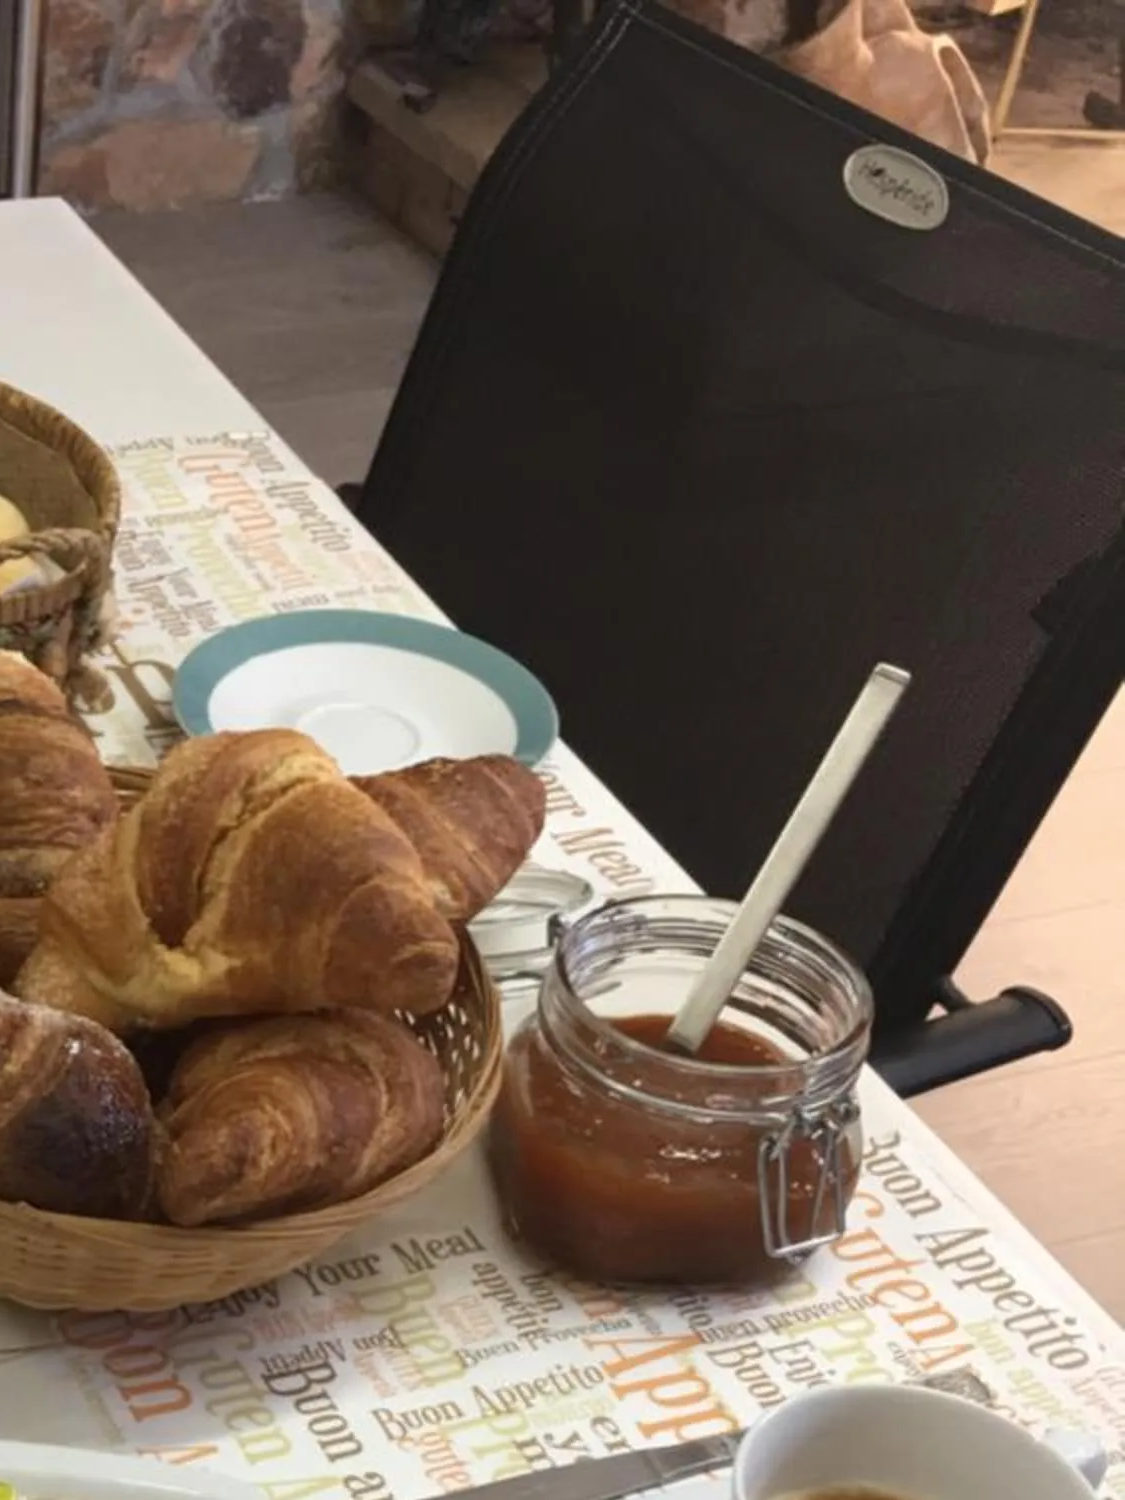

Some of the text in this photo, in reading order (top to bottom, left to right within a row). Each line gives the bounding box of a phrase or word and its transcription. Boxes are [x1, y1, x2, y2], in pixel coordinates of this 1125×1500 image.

[293, 1252, 382, 1296] Your
[391, 1226, 487, 1275] Meal
[762, 1290, 878, 1336] provecho
[915, 1226, 1091, 1371] Appetito
[456, 1337, 520, 1371] Buen
[260, 1360, 365, 1464] Buon
[371, 1363, 605, 1441] Buon Appetito
